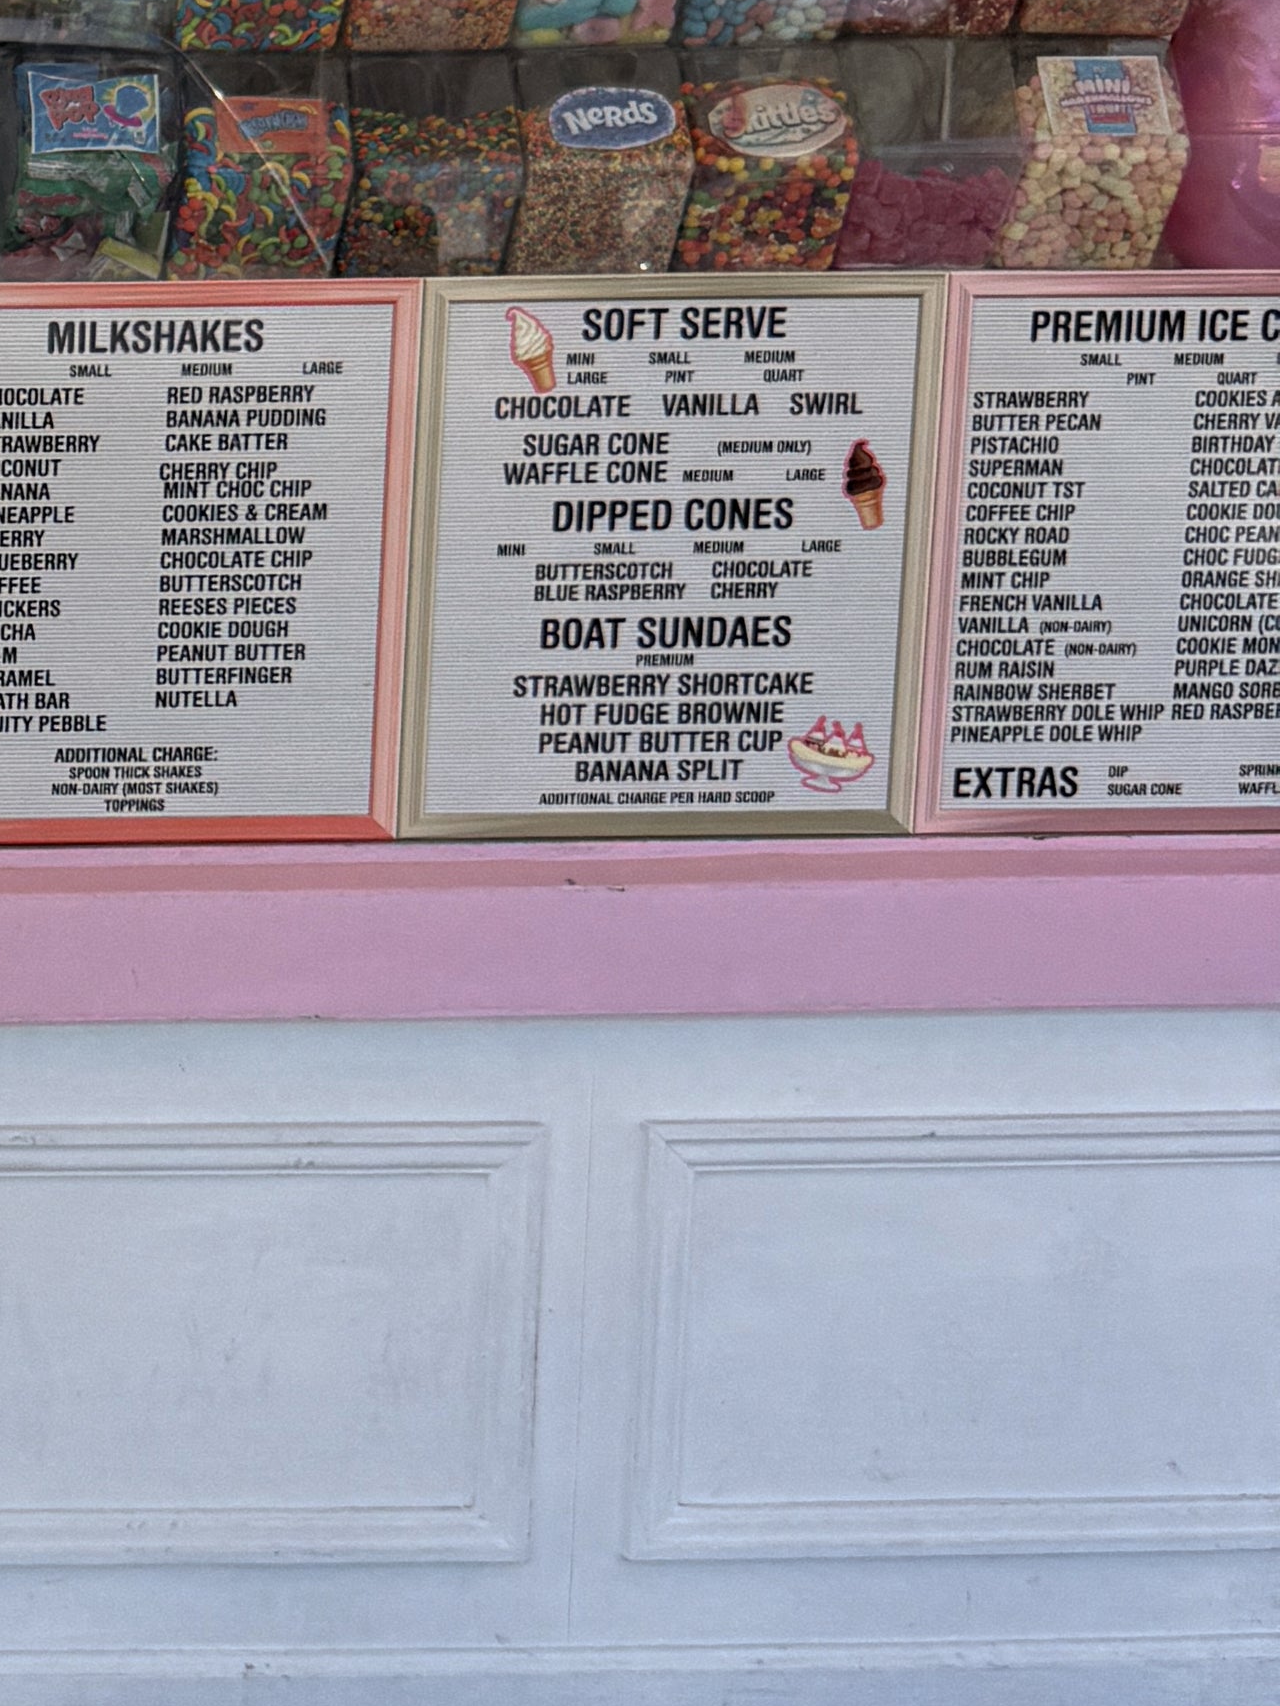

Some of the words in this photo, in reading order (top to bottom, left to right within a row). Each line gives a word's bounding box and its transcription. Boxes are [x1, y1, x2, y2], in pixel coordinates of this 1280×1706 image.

[1075, 75, 1130, 94] MINI
[582, 308, 668, 341] SOFT
[680, 307, 788, 340] SERVE
[1030, 310, 1186, 343] PREMIUM
[1198, 310, 1249, 342] ICE
[48, 319, 265, 354] MILKSHAKES
[566, 371, 608, 385] LARGE
[664, 370, 694, 383] PINT
[762, 369, 804, 383] QUART
[790, 392, 863, 416] SWIRL
[166, 410, 239, 429] BANANA
[246, 409, 326, 427] PUDDING
[971, 414, 1040, 432] BUTTER
[1046, 414, 1102, 432] PECAN
[717, 440, 774, 456] (MEDIUM
[777, 439, 812, 455] ONLY)
[970, 436, 1059, 455] PISTACHIO
[1191, 436, 1275, 455] BIRTHDAY
[503, 462, 598, 485] WAFFLE
[606, 461, 668, 484] CONE
[552, 499, 672, 532] DIPPED
[684, 498, 794, 530] CONES
[160, 528, 306, 546] MARSHMALLOW
[159, 574, 302, 593] BUTTERSCOTCH
[540, 618, 625, 649] BOAT
[637, 615, 792, 648] SUNDAES
[958, 617, 1029, 635] VANILLA
[1039, 619, 1112, 635] (NON-DAIRY)
[1177, 615, 1253, 633] UNICORN
[635, 653, 694, 667] PREMIUM
[513, 674, 671, 698] STRAWBERRY
[677, 672, 814, 696] SHORTCAKE
[35, 692, 70, 710] BAR
[155, 691, 237, 709] NUTELLA
[950, 724, 1045, 743] PINEAPPLE
[1049, 724, 1093, 742] DOLE
[1098, 724, 1143, 742] WHIP
[69, 766, 110, 780] SPOON
[113, 766, 150, 780] THICK
[153, 765, 202, 779] SHAKES
[953, 766, 1079, 798] EXTRAS
[538, 792, 614, 806] ADDITIONAL
[617, 791, 667, 805] CHARGE
[670, 791, 695, 804] PER
[697, 790, 732, 804] HARD
[735, 790, 775, 803] SCOOP
[1107, 783, 1147, 796] SUGAR
[1150, 782, 1182, 796] CONE
[104, 799, 165, 813] TOPPINGS
